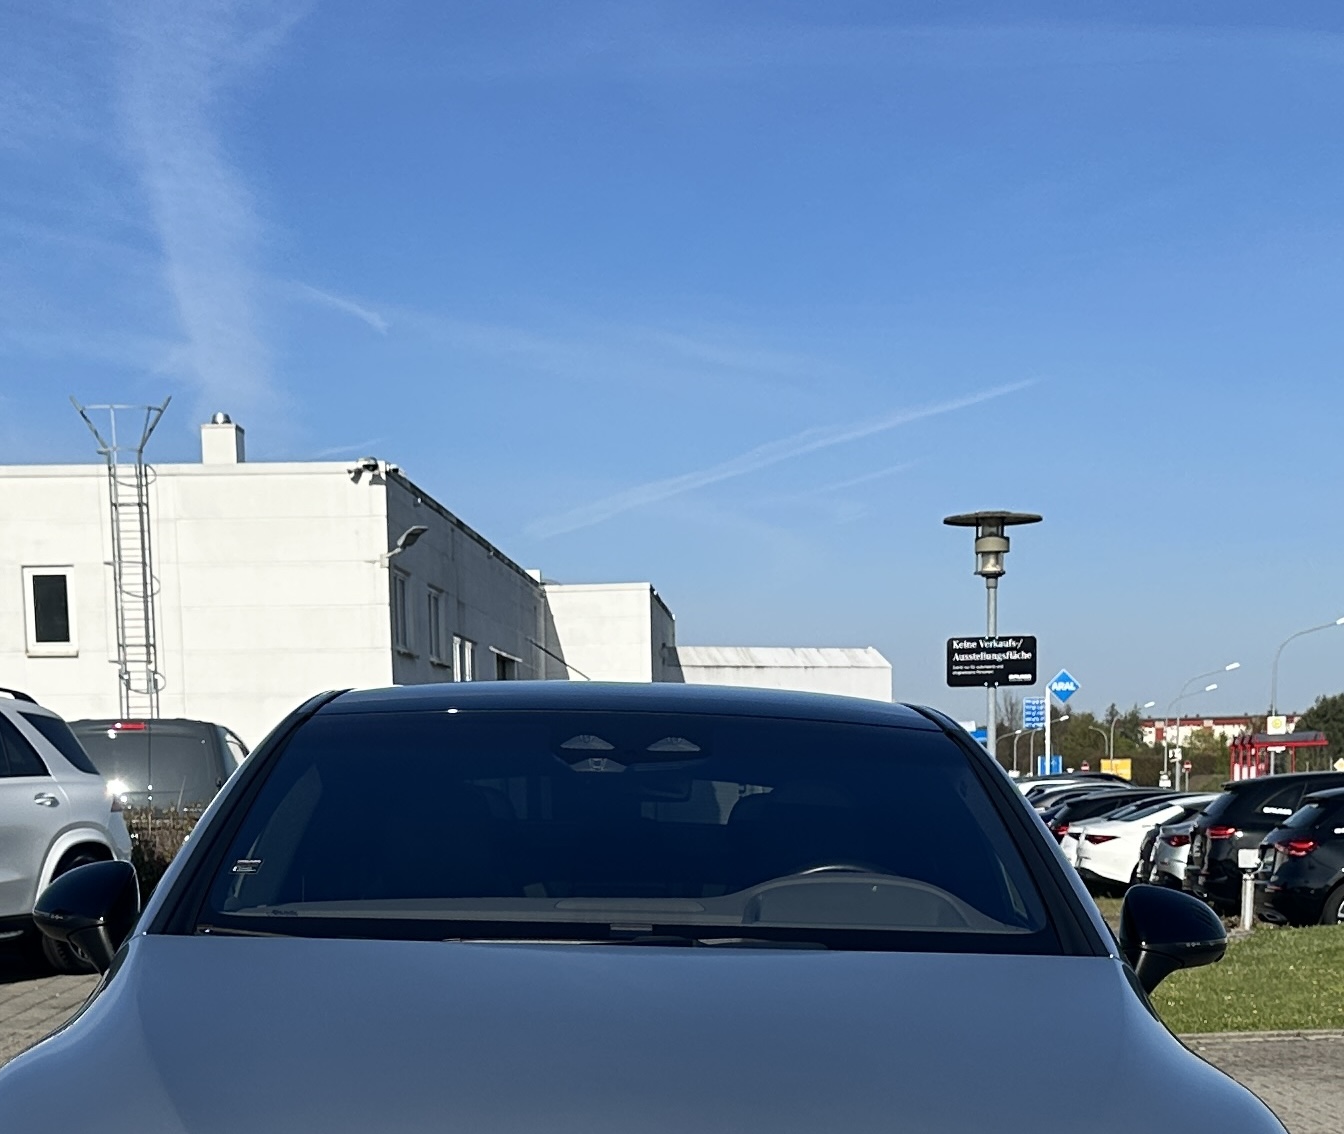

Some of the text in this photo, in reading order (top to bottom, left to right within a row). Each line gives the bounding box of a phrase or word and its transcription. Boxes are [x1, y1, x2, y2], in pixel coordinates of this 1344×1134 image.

[952, 640, 977, 649] Keine
[952, 650, 1032, 662] Ausstellungsfläche
[1052, 682, 1076, 691] ARAL
